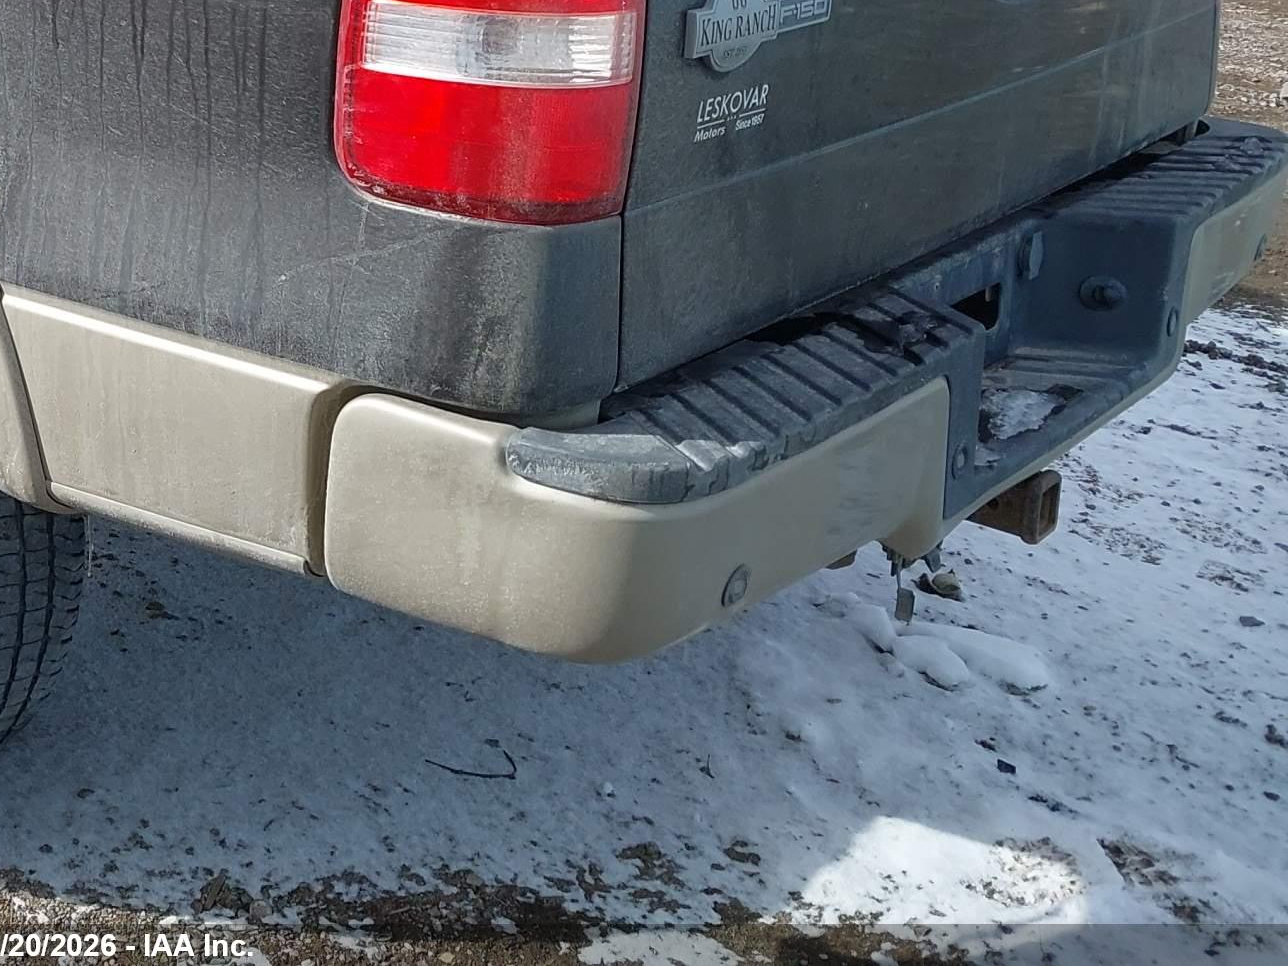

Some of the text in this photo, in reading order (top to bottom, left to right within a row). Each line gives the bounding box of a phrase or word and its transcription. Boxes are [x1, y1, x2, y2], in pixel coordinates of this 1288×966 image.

[700, 3, 777, 47] KING RANCH
[696, 83, 770, 124] LESKOVAR
[693, 126, 726, 143] Motors
